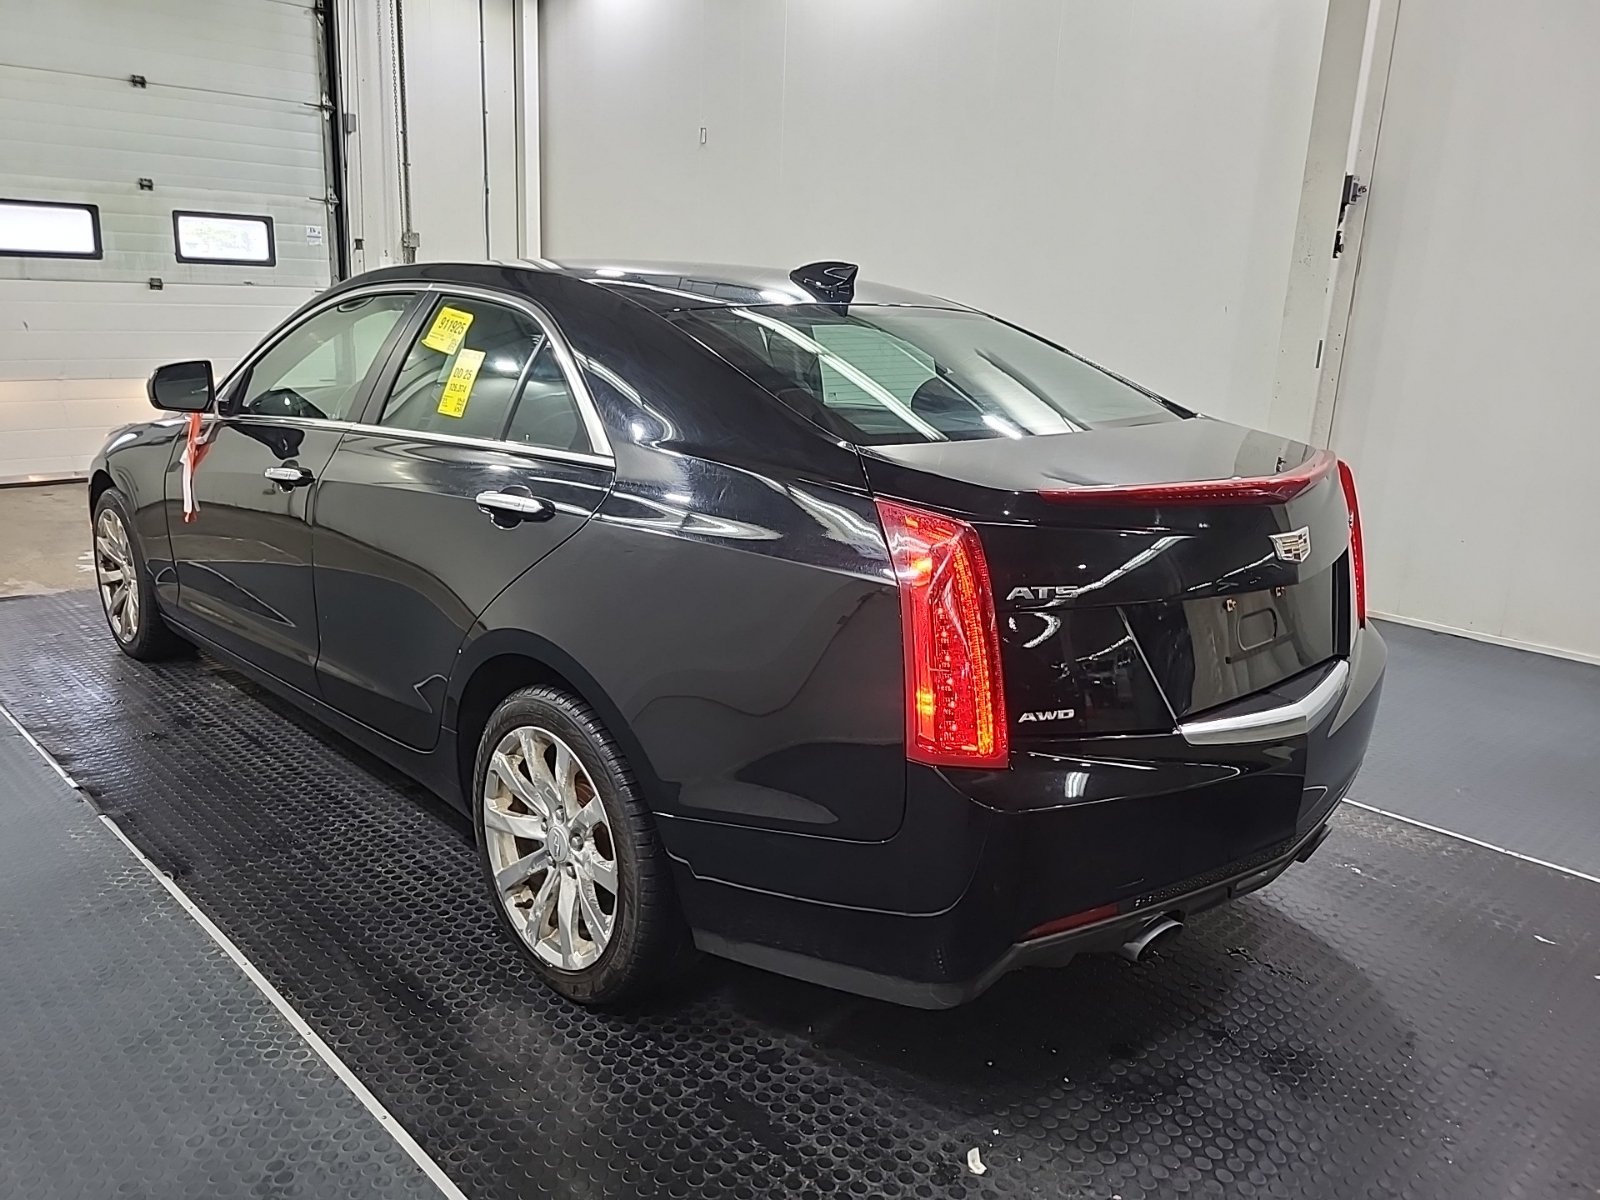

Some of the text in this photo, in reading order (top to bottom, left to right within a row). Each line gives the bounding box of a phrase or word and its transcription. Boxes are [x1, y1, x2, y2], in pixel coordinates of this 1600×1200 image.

[438, 317, 466, 334] 911925
[1005, 585, 1079, 600] ATS
[1018, 708, 1075, 723] AWD
